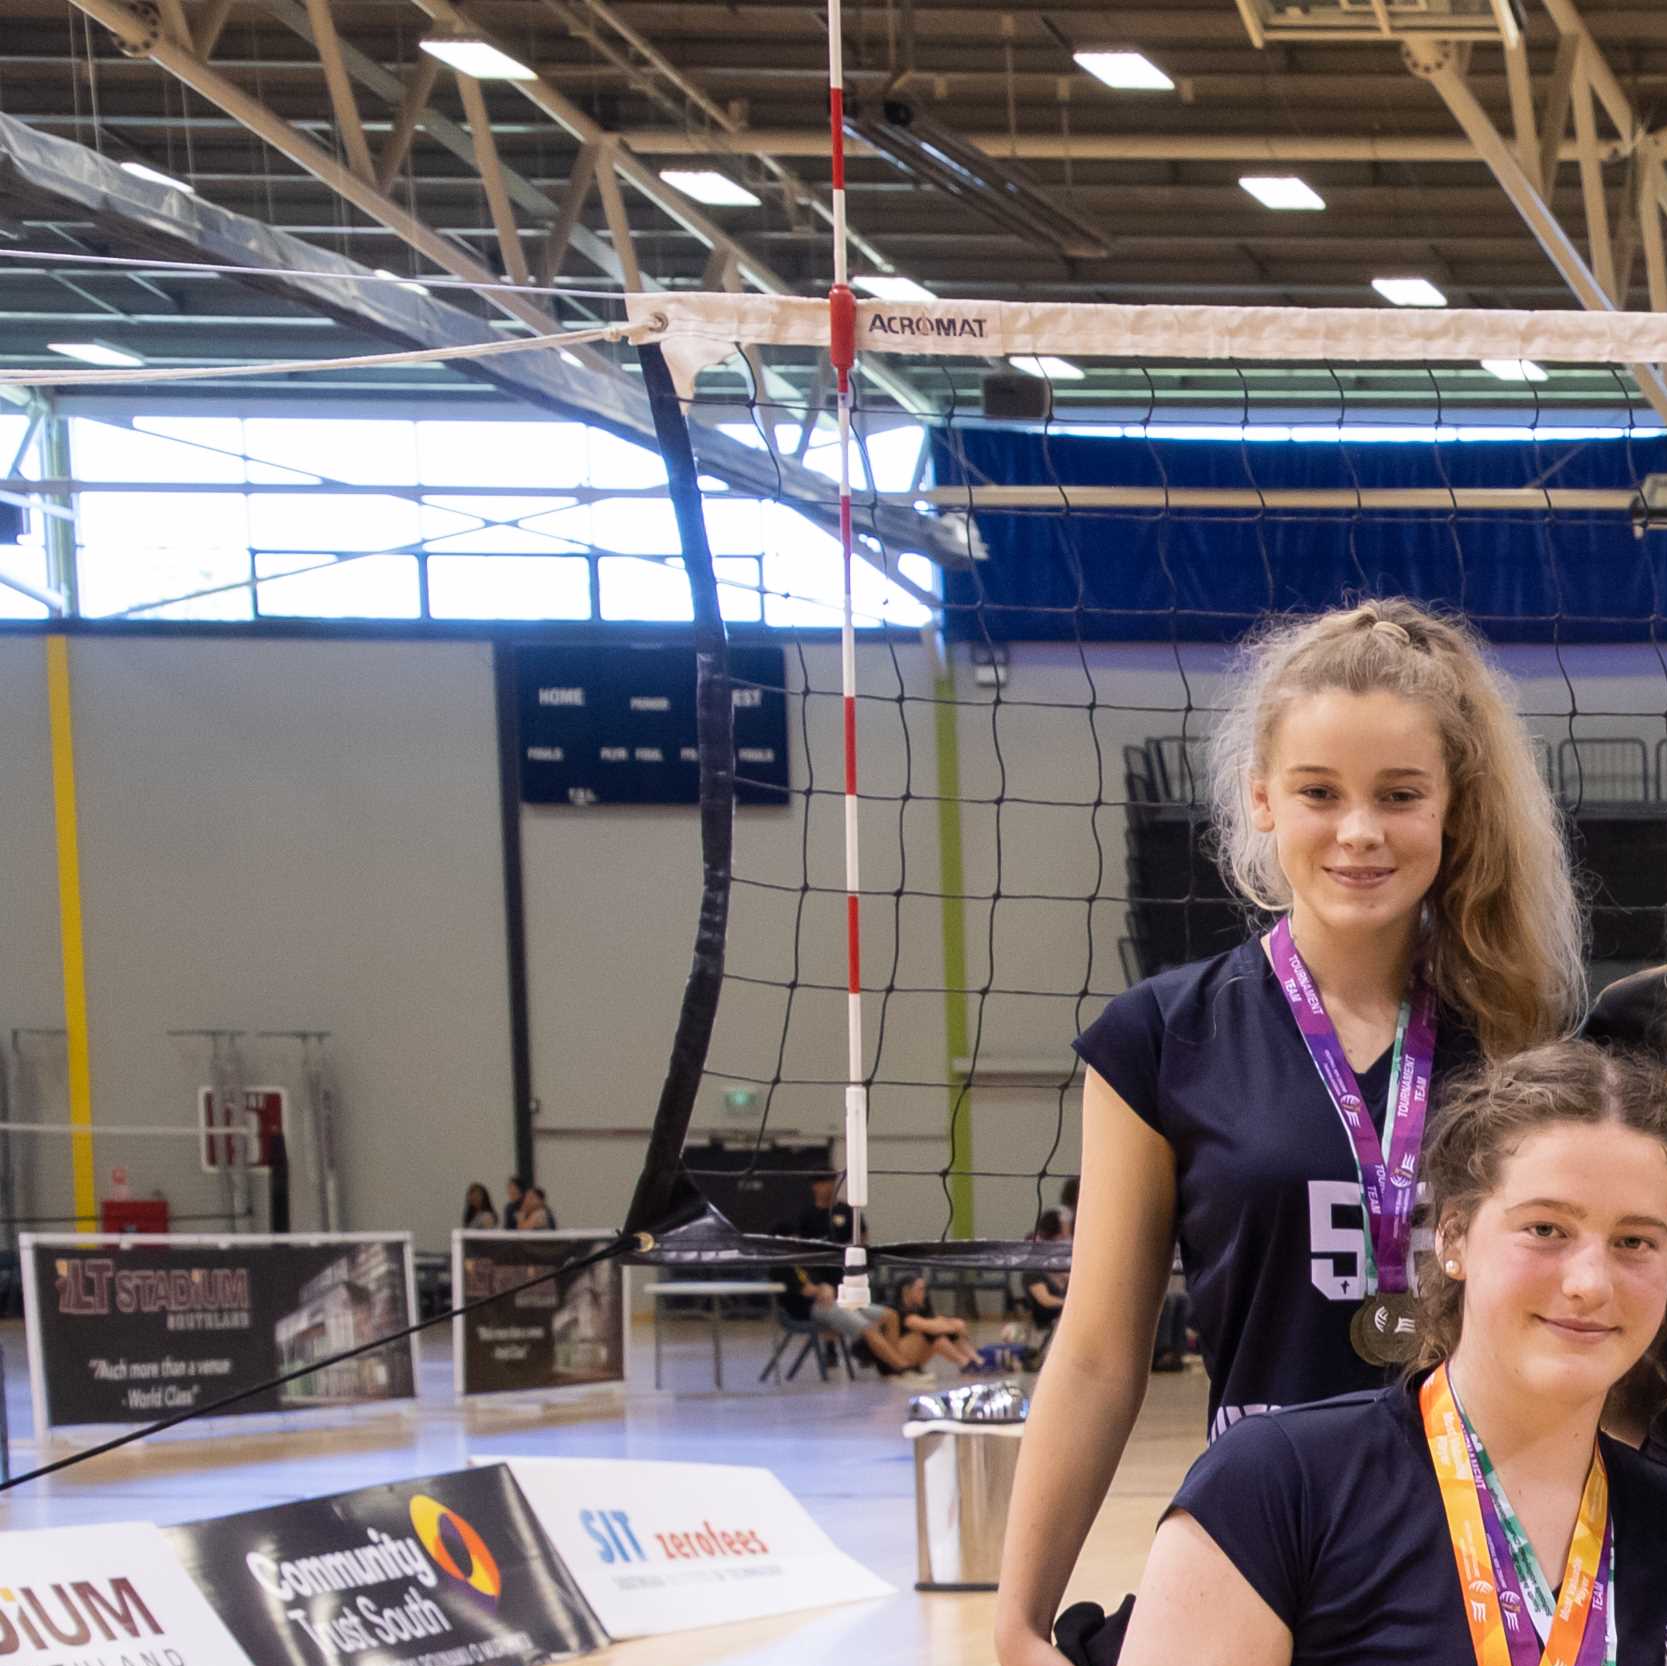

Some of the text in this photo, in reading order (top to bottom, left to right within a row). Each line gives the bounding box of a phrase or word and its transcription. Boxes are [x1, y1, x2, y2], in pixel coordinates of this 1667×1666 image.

[869, 314, 987, 338] ACROMAT
[539, 687, 585, 706] HOME
[731, 689, 762, 706] EST
[1284, 979, 1302, 1003] TEAM
[1288, 954, 1323, 1015] TOURNAMENT
[1397, 1055, 1415, 1118] TOURNAMENT
[1415, 1076, 1427, 1102] TEAM
[130, 1360, 157, 1379] more
[161, 1357, 186, 1378] than
[580, 1509, 648, 1564] SIT
[246, 1527, 438, 1601] Community
[1592, 1581, 1604, 1610] TEAM
[356, 1586, 454, 1646] South
